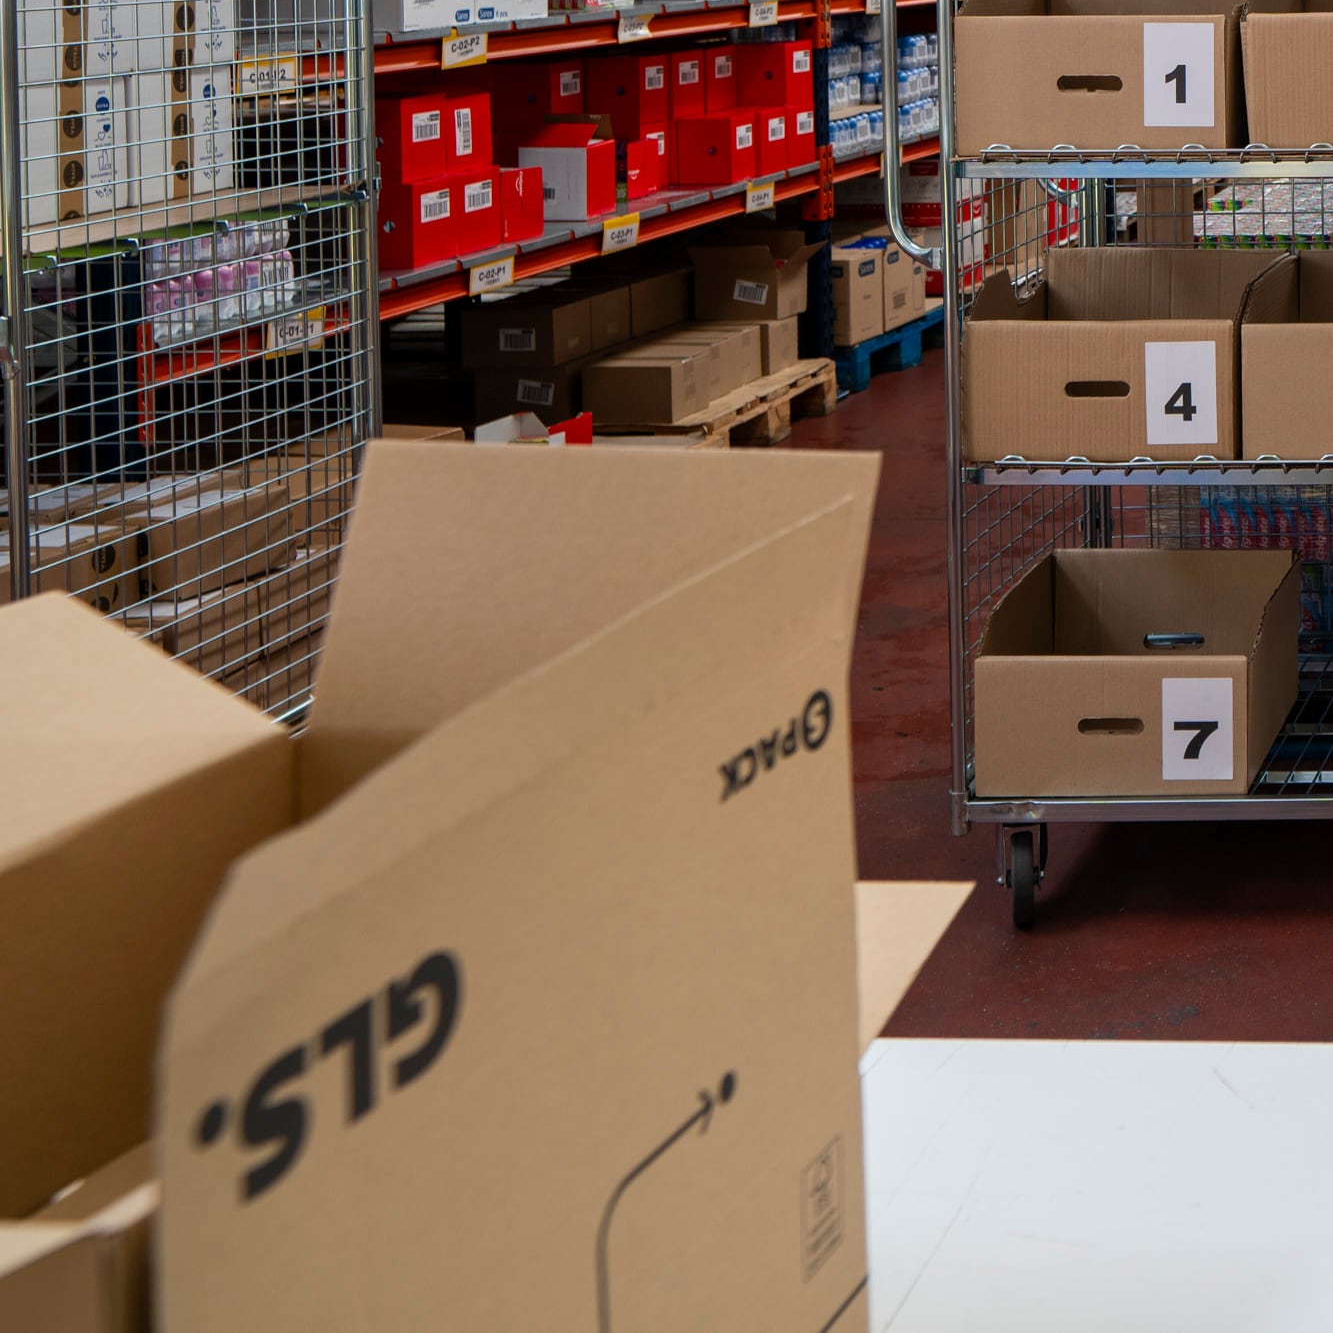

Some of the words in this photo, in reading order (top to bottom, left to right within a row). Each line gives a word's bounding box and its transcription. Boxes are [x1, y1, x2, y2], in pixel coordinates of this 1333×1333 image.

[479, 9, 493, 18] Sanex
[451, 36, 480, 53] C-02-P2
[1166, 65, 1187, 103] 1
[752, 193, 769, 204] C-04-P1
[610, 228, 633, 241] C-03-P1
[478, 266, 506, 282] C-02-P1
[1165, 383, 1197, 421] 4
[1174, 721, 1219, 760] 7
